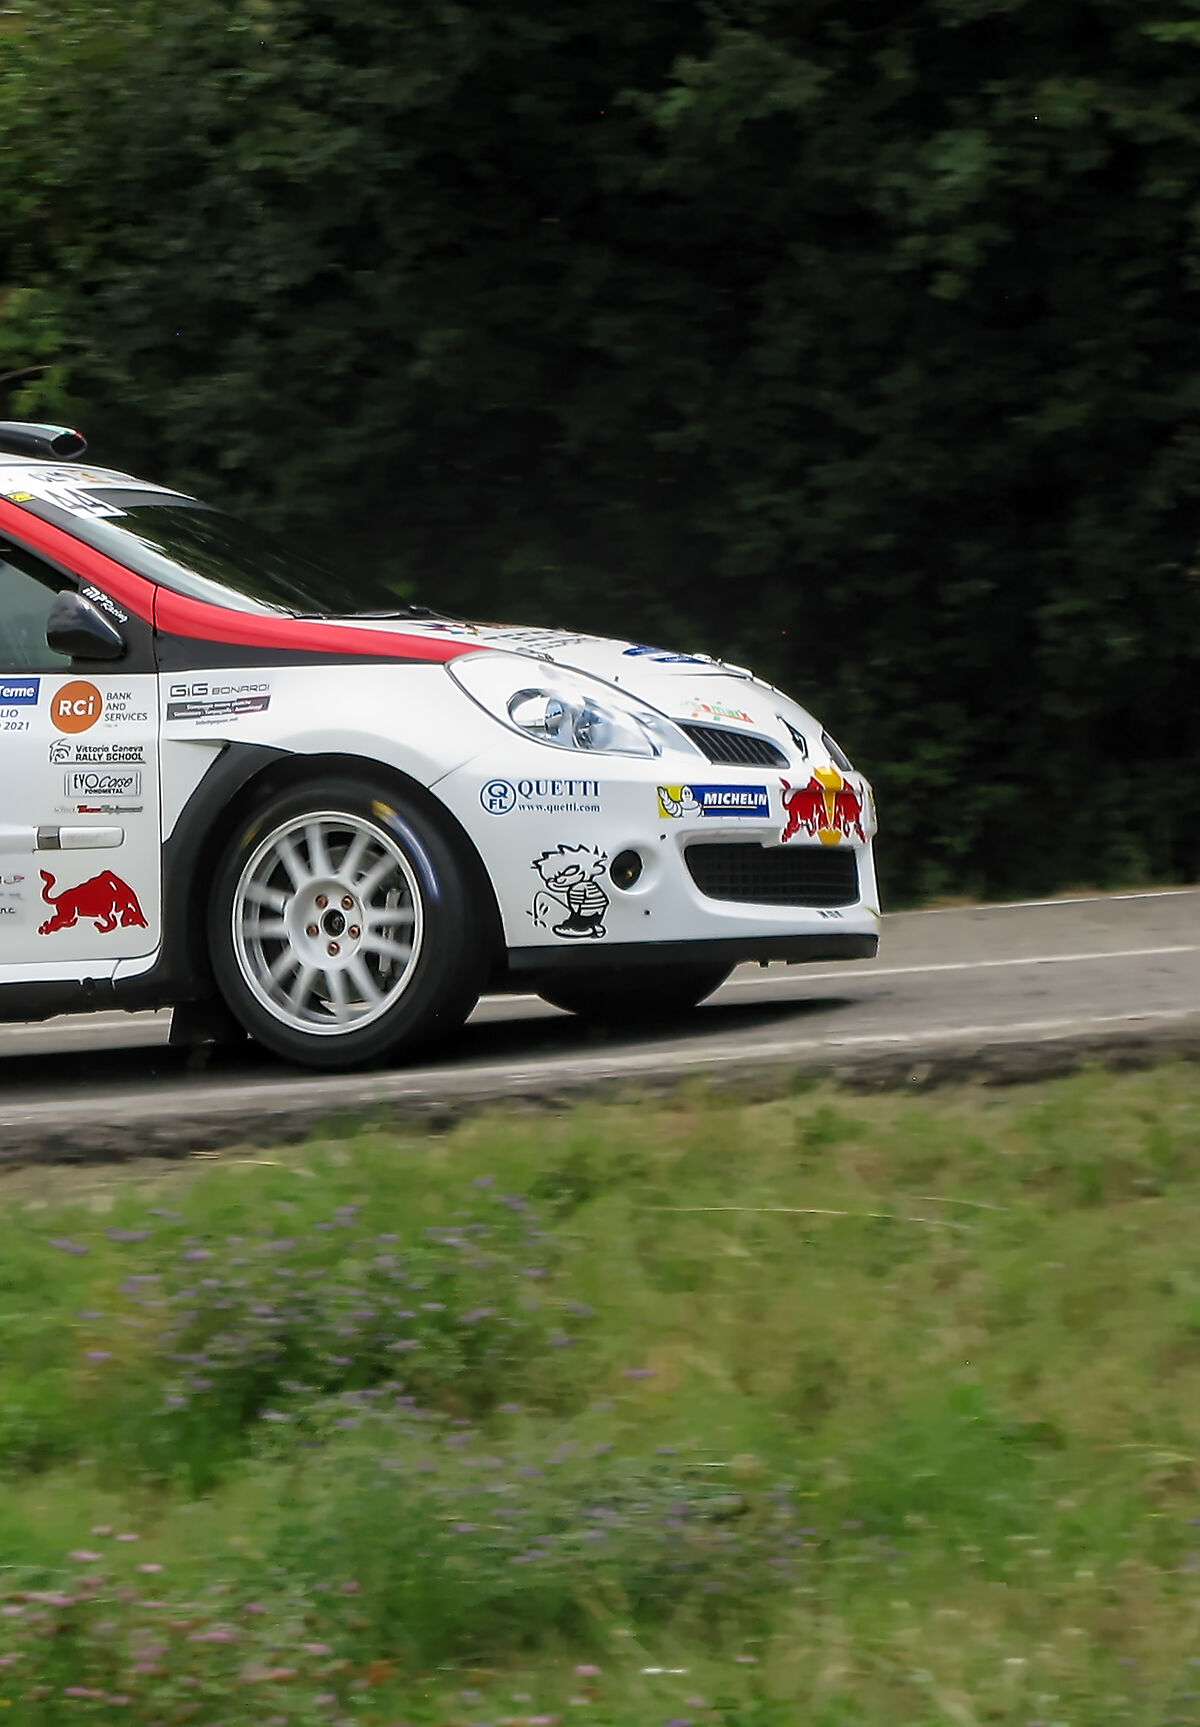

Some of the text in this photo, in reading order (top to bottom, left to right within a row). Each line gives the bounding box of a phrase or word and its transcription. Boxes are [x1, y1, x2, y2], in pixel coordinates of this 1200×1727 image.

[106, 692, 132, 701] BANK
[105, 703, 126, 711] AND
[104, 712, 148, 722] SERVICES
[3, 722, 30, 731] 2021
[76, 744, 143, 753] Vittorio Caneva
[75, 753, 143, 761] RALLY SCHOOL
[518, 780, 600, 800] QUETTI
[703, 792, 768, 806] MICHELIN
[489, 799, 508, 810] FL
[518, 803, 600, 814] www.quetti.com
